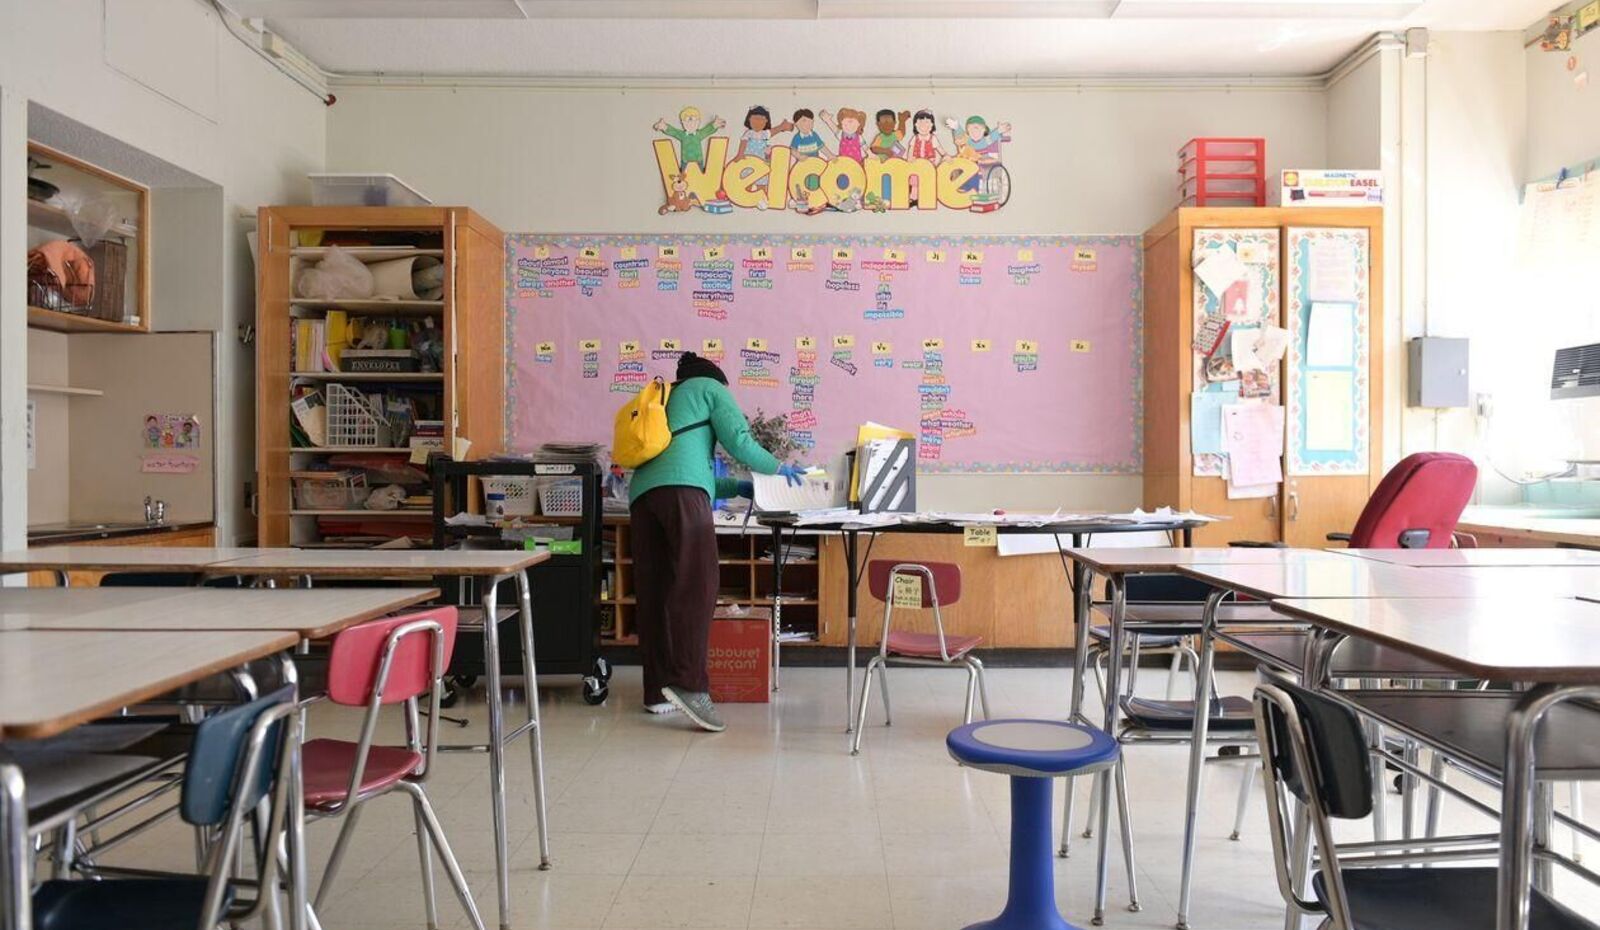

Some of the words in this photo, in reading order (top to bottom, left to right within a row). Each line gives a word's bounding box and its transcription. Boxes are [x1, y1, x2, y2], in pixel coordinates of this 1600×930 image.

[652, 136, 979, 210] Welcome
[1350, 179, 1378, 187] EASEL
[613, 259, 649, 269] countries
[742, 260, 773, 269] favorite
[861, 261, 908, 270] independent
[575, 266, 608, 276] beautiful
[695, 270, 733, 280] especially
[749, 269, 766, 277] first
[544, 279, 575, 287] another
[702, 280, 732, 290] exciting
[743, 279, 773, 289] friendly
[826, 280, 860, 291] hopeless
[582, 286, 593, 297] by
[693, 291, 734, 302] everything
[698, 309, 728, 320] enough
[864, 311, 904, 320] impossible
[652, 350, 681, 360] questio
[740, 349, 780, 364] something
[618, 362, 643, 371] pretty
[745, 359, 763, 368] said
[615, 373, 647, 382] prettiest
[790, 375, 820, 385] through
[795, 384, 814, 393] their
[792, 393, 814, 402] there
[921, 420, 941, 428] what
[941, 420, 973, 429] weather
[970, 528, 990, 536] Table
[895, 576, 914, 584] Chair
[708, 647, 760, 658] abouret
